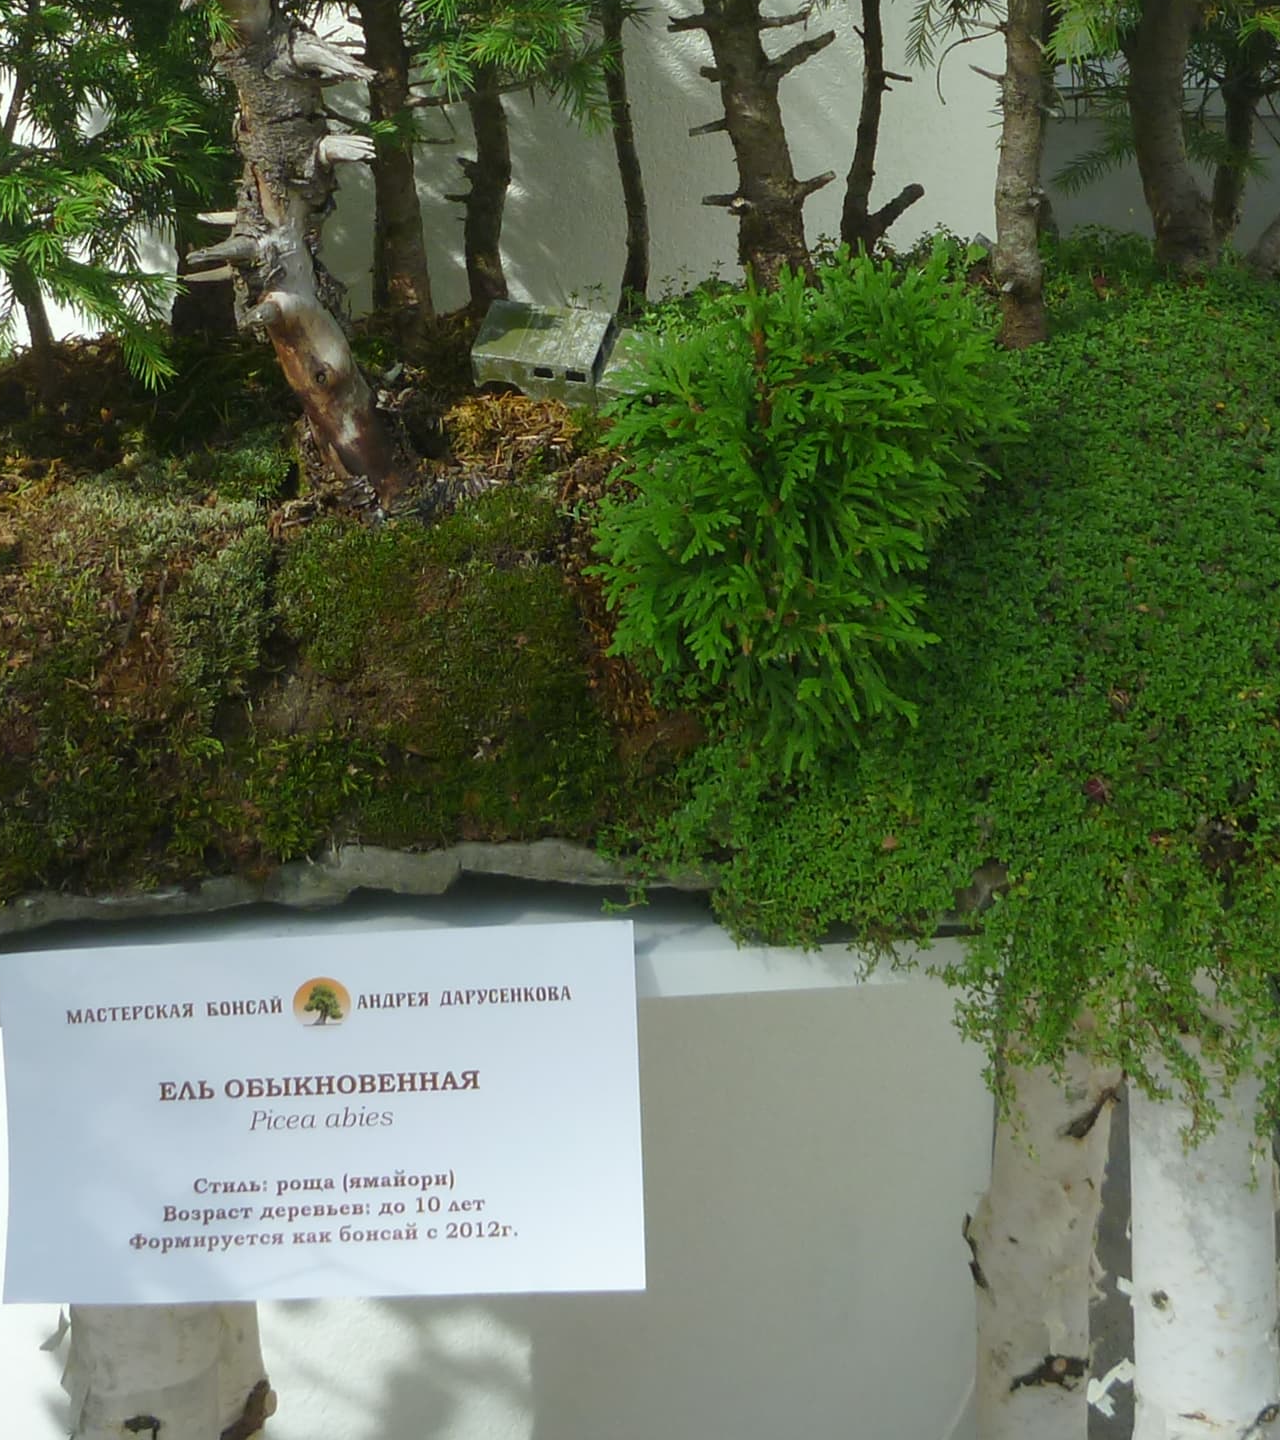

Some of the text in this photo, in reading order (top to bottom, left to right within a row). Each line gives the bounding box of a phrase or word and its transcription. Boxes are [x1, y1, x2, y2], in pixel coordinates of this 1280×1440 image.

[66, 985, 572, 1025] МАСТЕРСКАЯ БОНСАЙ АНДРЕЯ ДАРУСЕНКОВА
[158, 1069, 481, 1102] ЕЛЬ ОБЫКНОВЕННАЯ
[249, 1105, 394, 1132] Picea abies
[193, 1169, 455, 1197] Стиль: роща (ямайори)
[162, 1196, 486, 1227] Возраст деревьев: до 10 лет
[128, 1220, 519, 1255] Формируется как бонсай с 2012г.
